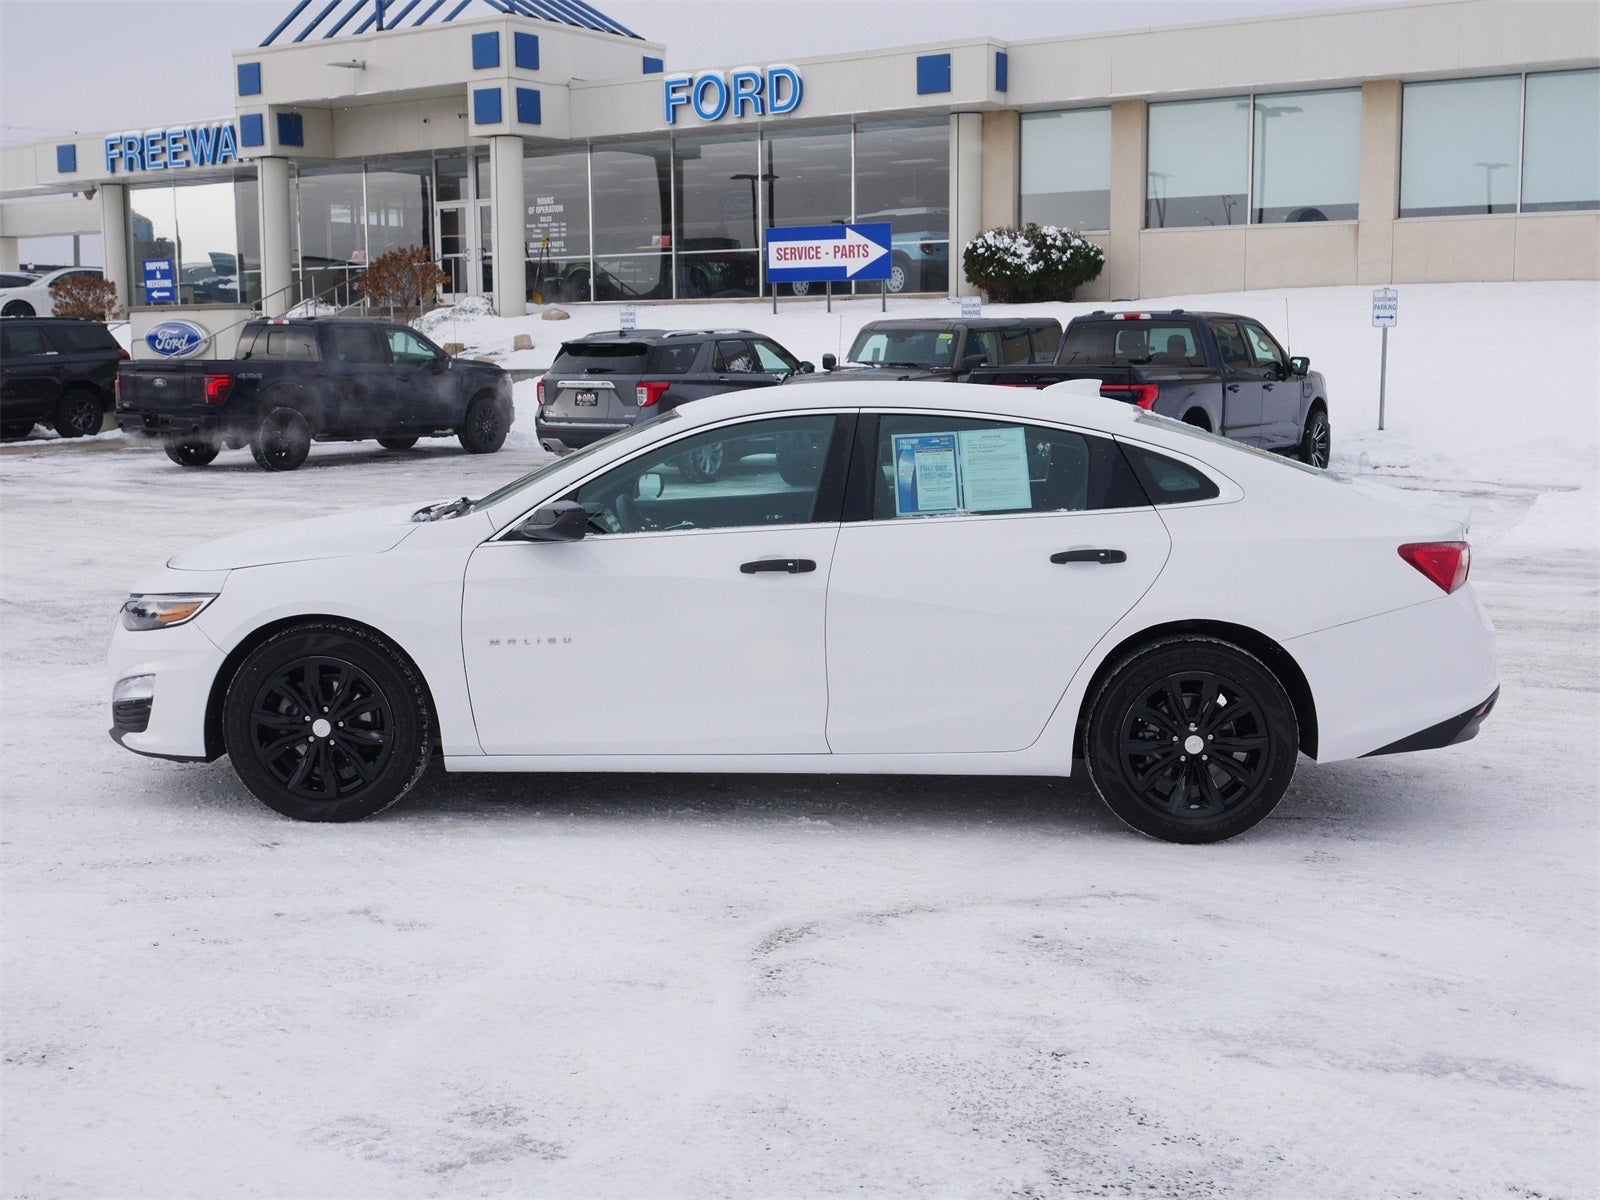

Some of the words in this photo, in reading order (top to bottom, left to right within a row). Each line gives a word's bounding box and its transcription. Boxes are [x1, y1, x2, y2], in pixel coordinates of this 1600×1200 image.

[664, 65, 804, 125] FORD
[104, 124, 240, 173] FREEWA
[536, 205, 563, 214] OPERATION
[776, 246, 821, 261] SERVICE
[833, 243, 869, 259] PARTS
[145, 261, 169, 270] SHIPPING
[146, 279, 172, 288] RECEIVING
[155, 328, 188, 350] Ford
[489, 637, 572, 646] MALIBU
